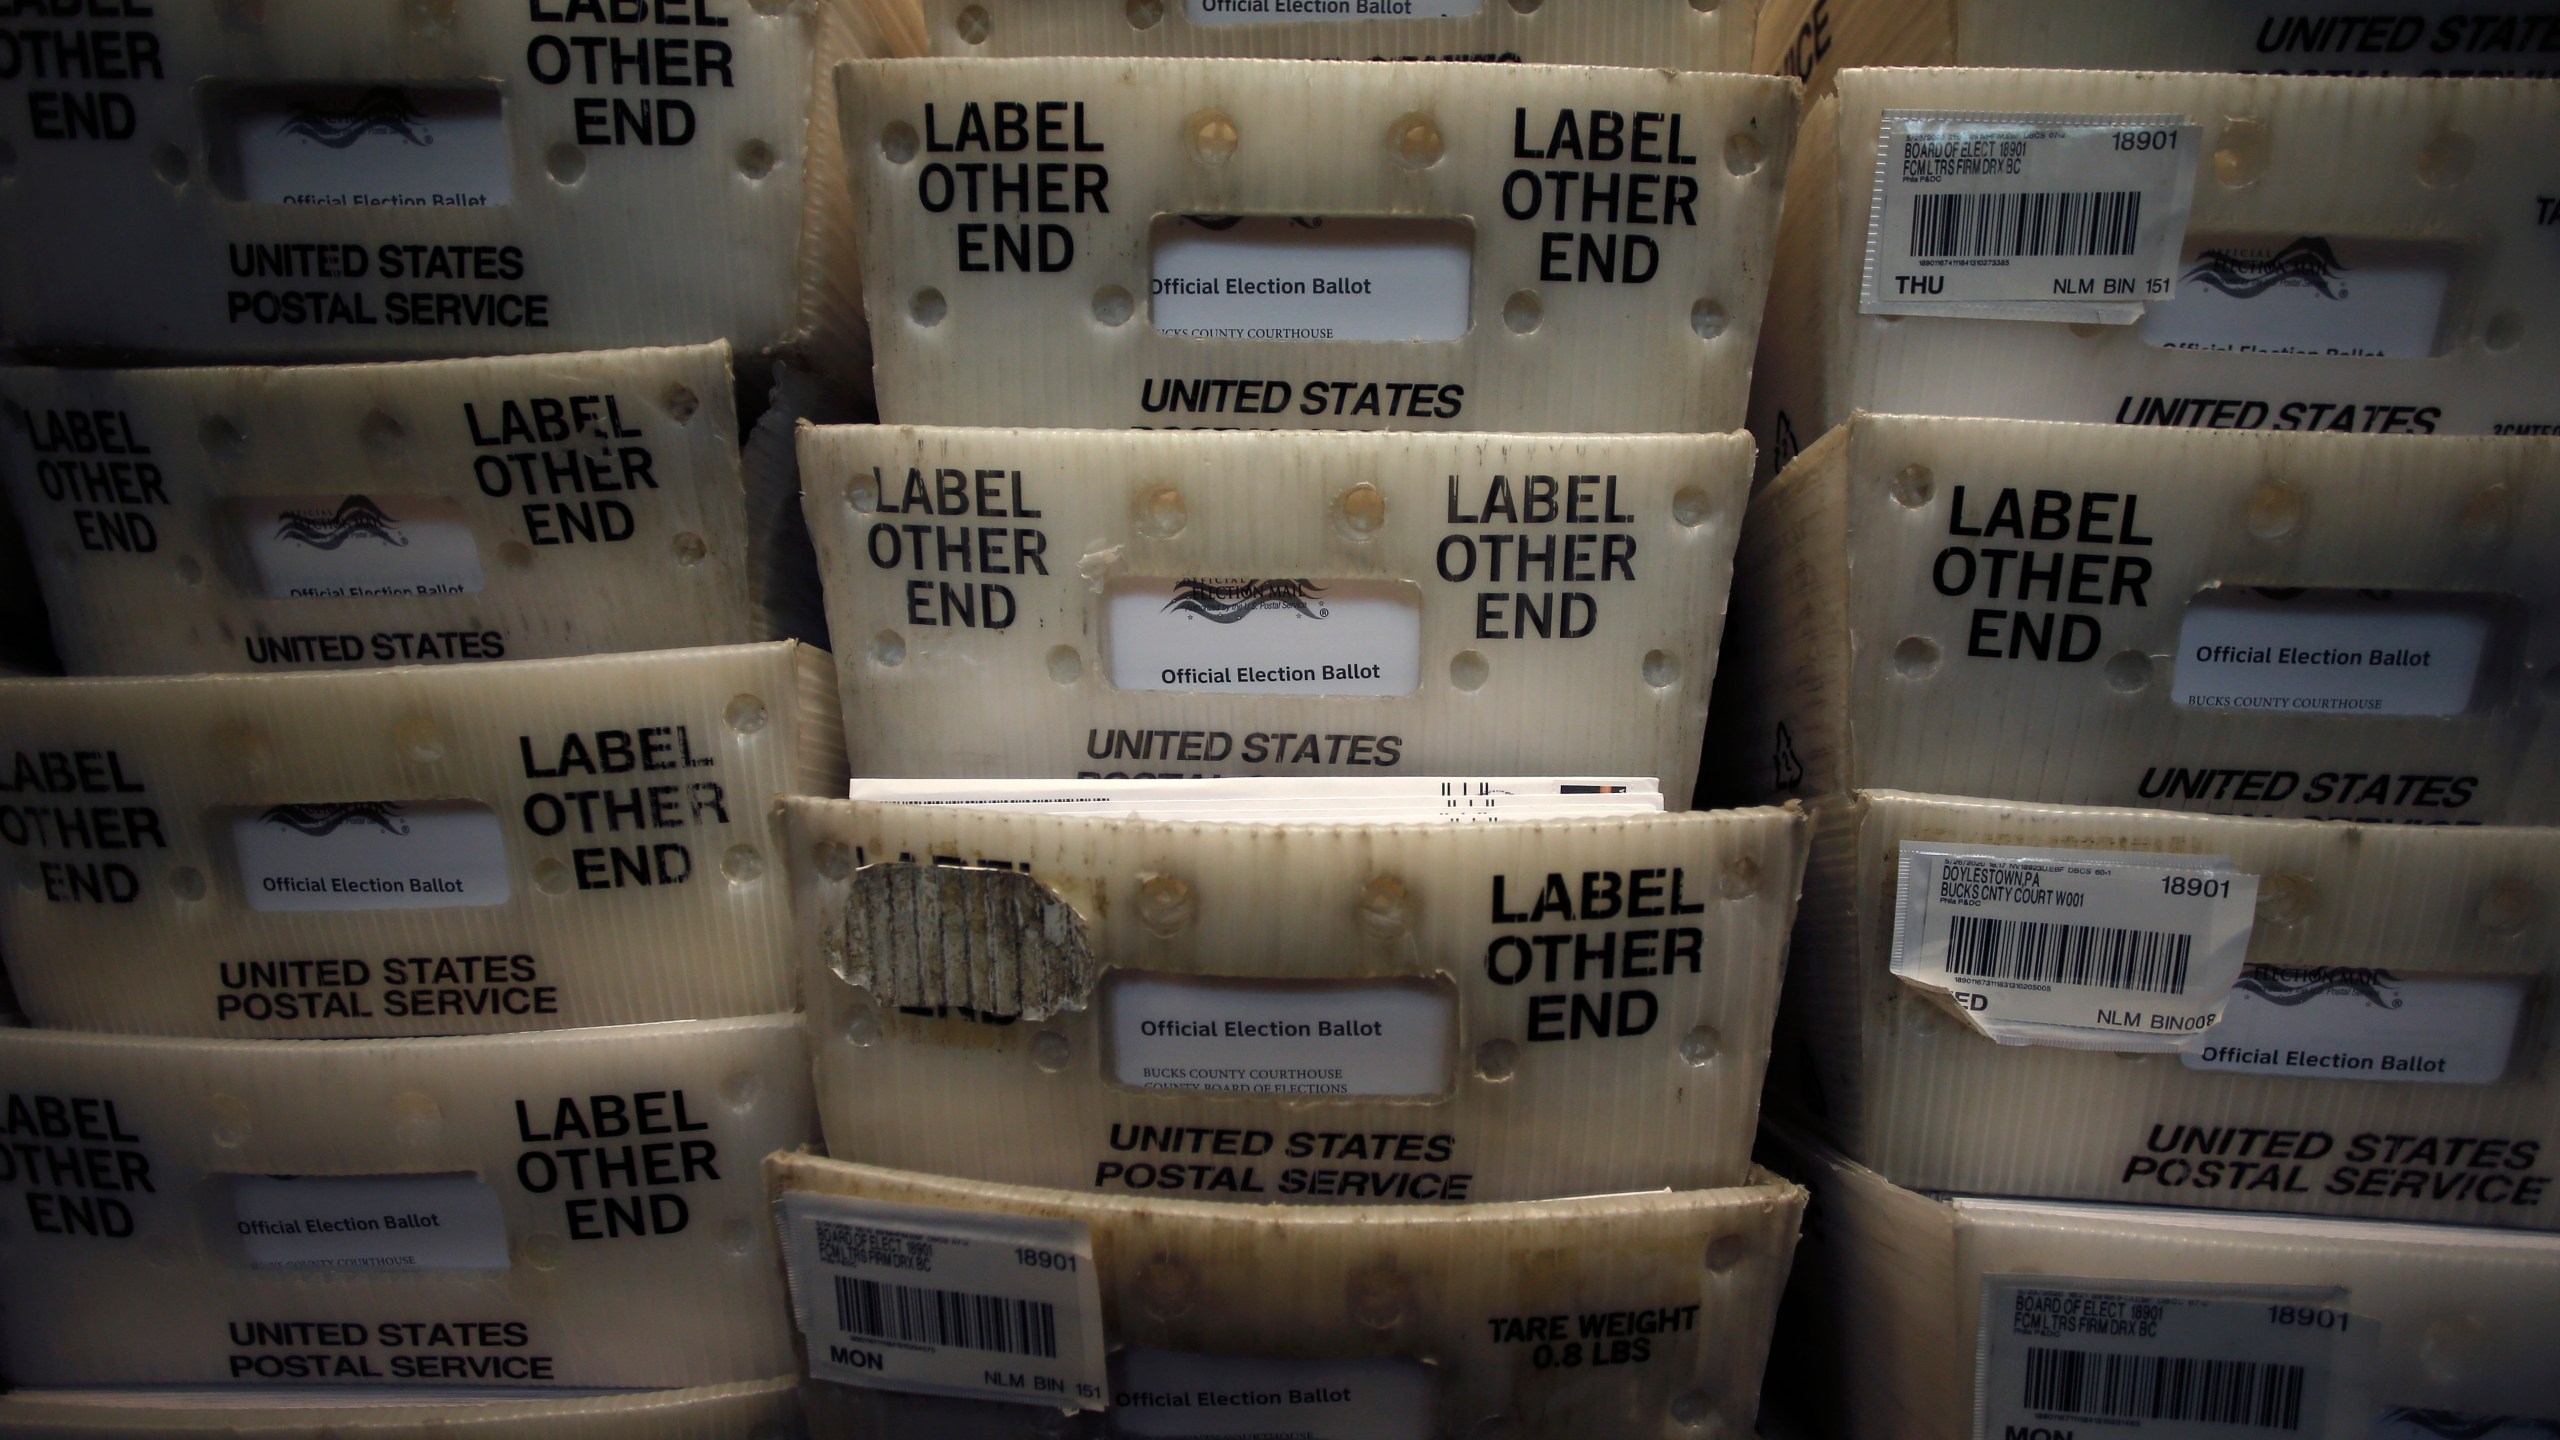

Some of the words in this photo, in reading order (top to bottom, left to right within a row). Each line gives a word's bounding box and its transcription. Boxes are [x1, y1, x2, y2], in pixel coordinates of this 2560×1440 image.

[2256, 16, 2425, 52] UNITED
[527, 36, 733, 87] OTHER
[28, 92, 136, 140] END
[575, 98, 696, 147] END
[924, 101, 1104, 152] LABEL
[1513, 107, 1697, 165] LABEL
[1904, 142, 1942, 158] BOARD
[1945, 142, 1959, 157] OF
[1961, 141, 1996, 157] ELECT
[2000, 141, 2027, 157] 18901
[2112, 130, 2178, 151] 18901
[1957, 159, 1981, 175] FIRM
[1983, 158, 2004, 174] DRX
[2007, 158, 2021, 174] BC
[918, 163, 1110, 213] OTHER
[1502, 169, 1699, 226] OTHER
[229, 244, 368, 280] UNITED
[378, 245, 524, 281] STATES
[957, 223, 1074, 272] END
[1540, 232, 1660, 284] END
[1152, 278, 1219, 295] Official
[1226, 278, 1305, 295] Election
[1312, 277, 1371, 294] Ballot
[1895, 276, 1945, 294] THU
[2053, 278, 2094, 294] NLM
[2104, 278, 2135, 294] BIN
[2146, 278, 2170, 294] 151
[227, 292, 377, 326] POSTAL
[385, 293, 549, 328] SERVICE
[1247, 328, 1333, 339] COURTHOUSE
[1140, 378, 1292, 413] UNITED
[1301, 381, 1464, 418] STATES
[2115, 397, 2269, 429] UNITED
[2273, 403, 2442, 434] STATES
[23, 409, 152, 455] LABEL
[463, 395, 643, 447] LABEL
[37, 462, 170, 506] OTHER
[473, 447, 659, 498] OTHER
[875, 468, 1041, 519] LABEL
[1448, 475, 1634, 525] LABEL
[73, 510, 158, 554] END
[522, 501, 635, 547] END
[1949, 485, 2154, 547] LABEL
[867, 523, 1049, 577] OTHER
[1437, 532, 1638, 583] OTHER
[1192, 586, 1264, 600] ELECTION
[1932, 546, 2153, 607] OTHER
[906, 580, 1017, 630] END
[1259, 601, 1281, 610] Postal
[1475, 591, 1598, 640] END
[245, 635, 364, 664] UNITED
[371, 632, 506, 662] STATES
[1967, 608, 2101, 663] END
[1162, 667, 1231, 684] Official
[1238, 666, 1315, 683] Election
[1322, 664, 1380, 681] Ballot
[2196, 645, 2271, 664] Official
[2278, 647, 2362, 666] Election
[2369, 649, 2431, 667] Ballot
[2188, 695, 2231, 707] BUCKS
[2233, 696, 2290, 709] COUNTY
[2292, 697, 2383, 710] COURTHOUSE
[520, 726, 715, 780] LABEL
[1087, 728, 1233, 761] UNITED
[1242, 733, 1402, 766] STATES
[2138, 768, 2299, 801] UNITED
[2303, 773, 2479, 808] STATES
[0, 805, 167, 849] OTHER
[523, 783, 730, 836] OTHER
[40, 861, 140, 903] END
[263, 877, 327, 893] Official
[332, 878, 404, 893] Election
[409, 878, 464, 893] Ballot
[573, 844, 692, 891] END
[1942, 866, 2040, 888] DOYLESTOWN,PA
[2162, 875, 2230, 898] 18901
[1490, 867, 1704, 924] LABEL
[1941, 881, 1979, 899] BUCKS
[1981, 885, 2014, 902] CNTY
[2014, 887, 2054, 905] COURT
[2056, 890, 2084, 907] W001
[219, 958, 371, 990] UNITED
[382, 955, 536, 986] STATES
[1483, 930, 1702, 985] OTHER
[217, 990, 374, 1022] POSTAL
[383, 986, 558, 1018] SERVICE
[1526, 990, 1658, 1044] END
[1951, 990, 1988, 1012] ED
[2098, 1009, 2142, 1027] NLM
[1141, 1020, 1217, 1037] Official
[1225, 1020, 1310, 1037] Election
[1318, 1020, 1382, 1037] Ballot
[1144, 1067, 1186, 1079] BUCKS
[1189, 1068, 1246, 1080] COUNTY
[1250, 1068, 1342, 1080] COURTHOUSE
[2201, 1046, 2277, 1065] Official
[2286, 1050, 2373, 1070] Election
[2381, 1055, 2446, 1073] Ballot
[516, 1090, 709, 1143] LABEL
[1109, 1124, 1273, 1159] UNITED
[1285, 1131, 1454, 1163] STATES
[2147, 1124, 2333, 1161] UNITED
[2346, 1132, 2541, 1170] STATES
[517, 1140, 721, 1195] OTHER
[1094, 1161, 1266, 1194] POSTAL
[1280, 1169, 1472, 1200] SERVICE
[2122, 1156, 2310, 1193] POSTAL
[2325, 1163, 2553, 1206] SERVICE
[26, 1192, 134, 1238] END
[238, 1220, 301, 1236] Official
[306, 1217, 379, 1233] Election
[384, 1213, 440, 1230] Ballot
[564, 1194, 689, 1242] END
[1015, 1247, 1077, 1272] 18901
[1487, 1314, 1567, 1345] TARE
[1578, 1305, 1699, 1340] WEIGHT
[2015, 1295, 2061, 1313] BOARD
[2064, 1299, 2081, 1315] OF
[2083, 1301, 2125, 1318] ELECT
[2131, 1305, 2164, 1321] 18901
[2078, 1317, 2107, 1334] FIRM
[2110, 1319, 2137, 1336] DRX
[2139, 1322, 2157, 1338] BC
[2267, 1304, 2348, 1332] 18901
[229, 1323, 368, 1347] UNITED
[378, 1323, 528, 1348] STATES
[1531, 1341, 1581, 1370] 0.8
[1592, 1335, 1651, 1367] LBS
[229, 1355, 382, 1379] POSTAL
[390, 1355, 554, 1380] SERVICE
[831, 1345, 883, 1370] MON
[984, 1371, 1025, 1388] NLM
[1034, 1376, 1064, 1393] BIN
[1075, 1383, 1100, 1399] 151
[1115, 1392, 1191, 1407] Official
[1198, 1390, 1282, 1406] Election
[1289, 1388, 1351, 1404] Ballot
